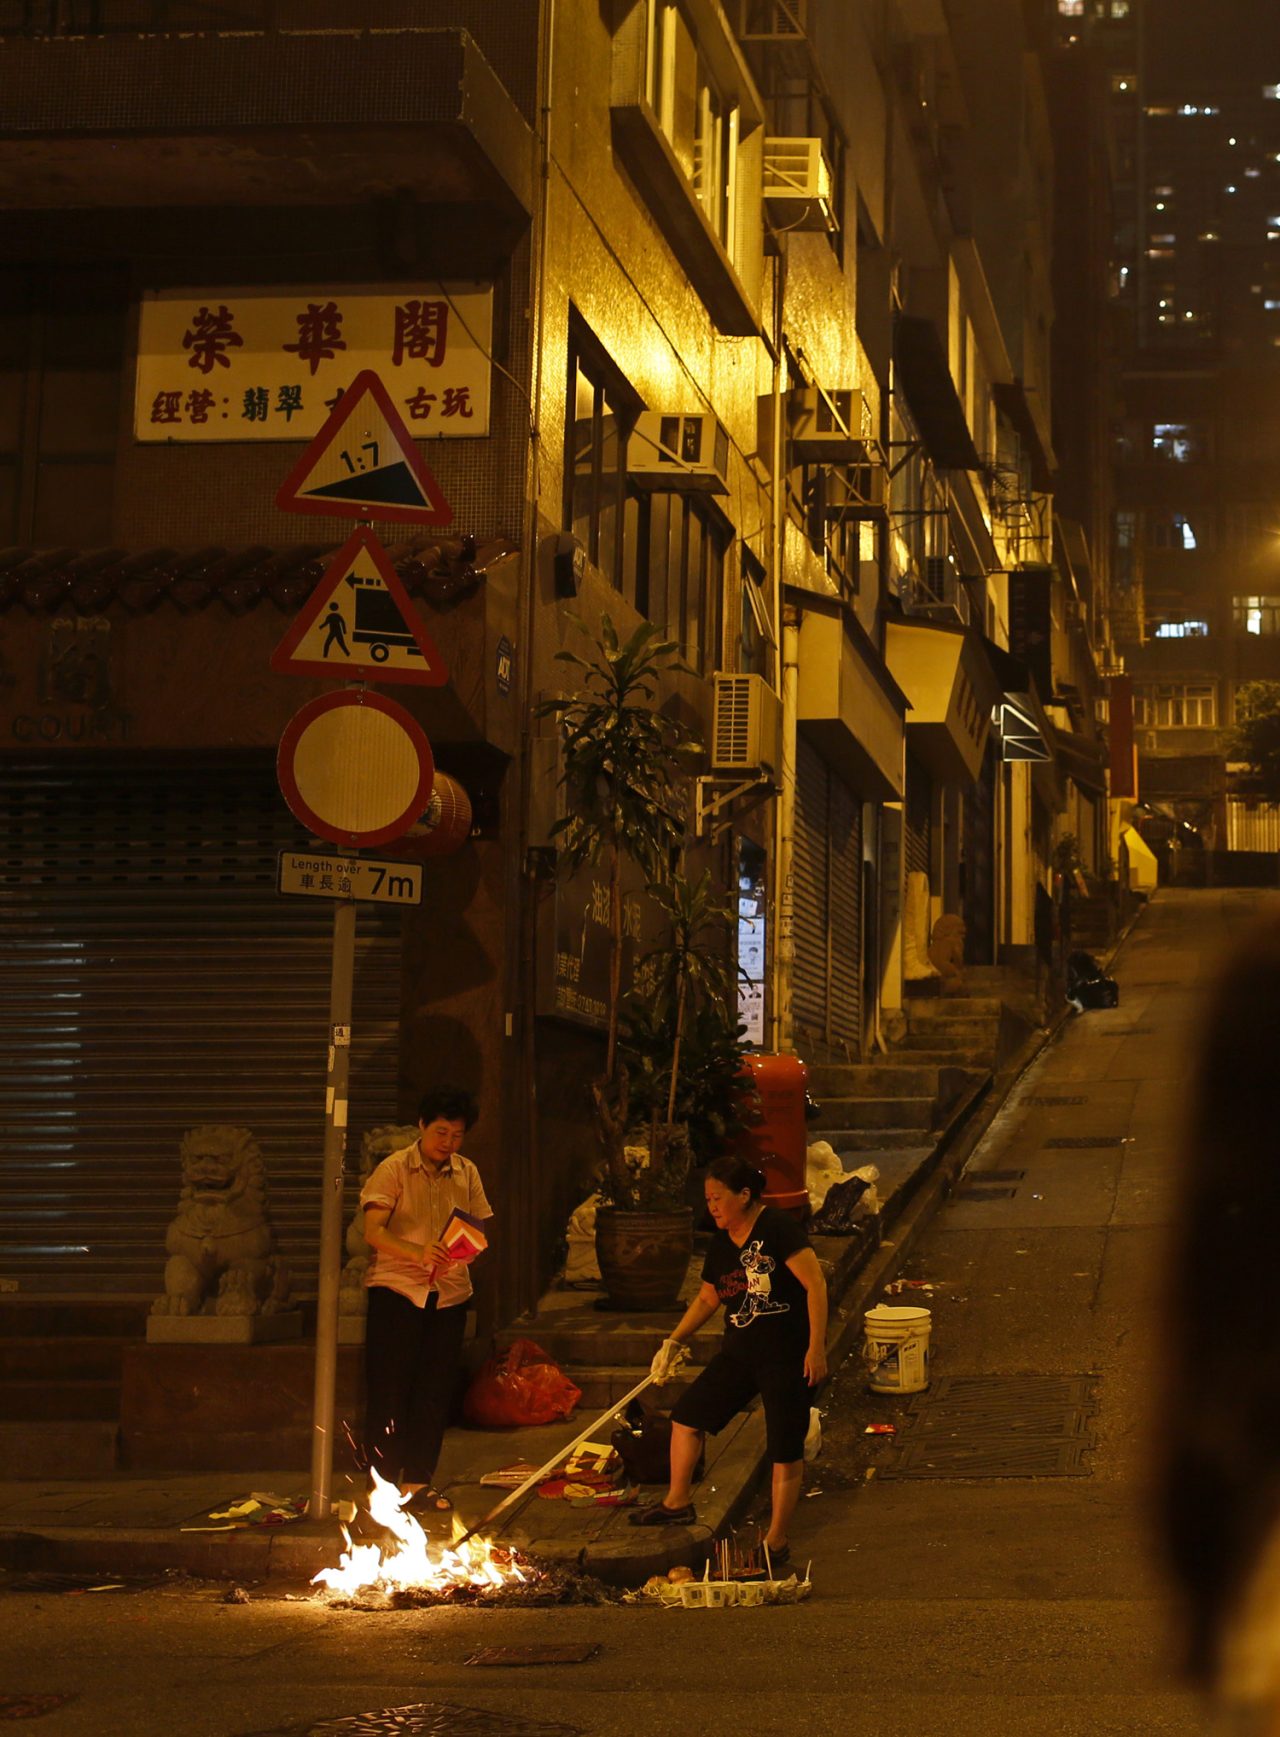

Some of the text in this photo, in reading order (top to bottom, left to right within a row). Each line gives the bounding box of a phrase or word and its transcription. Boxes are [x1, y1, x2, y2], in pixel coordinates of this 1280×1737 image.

[182, 301, 449, 375] 榮華閣
[241, 385, 304, 422] 翡翠
[405, 386, 473, 420] 古玩
[340, 441, 379, 473] 1:7
[291, 858, 362, 874] Length over
[368, 866, 414, 898] 7m
[299, 873, 352, 893] 車長逾
